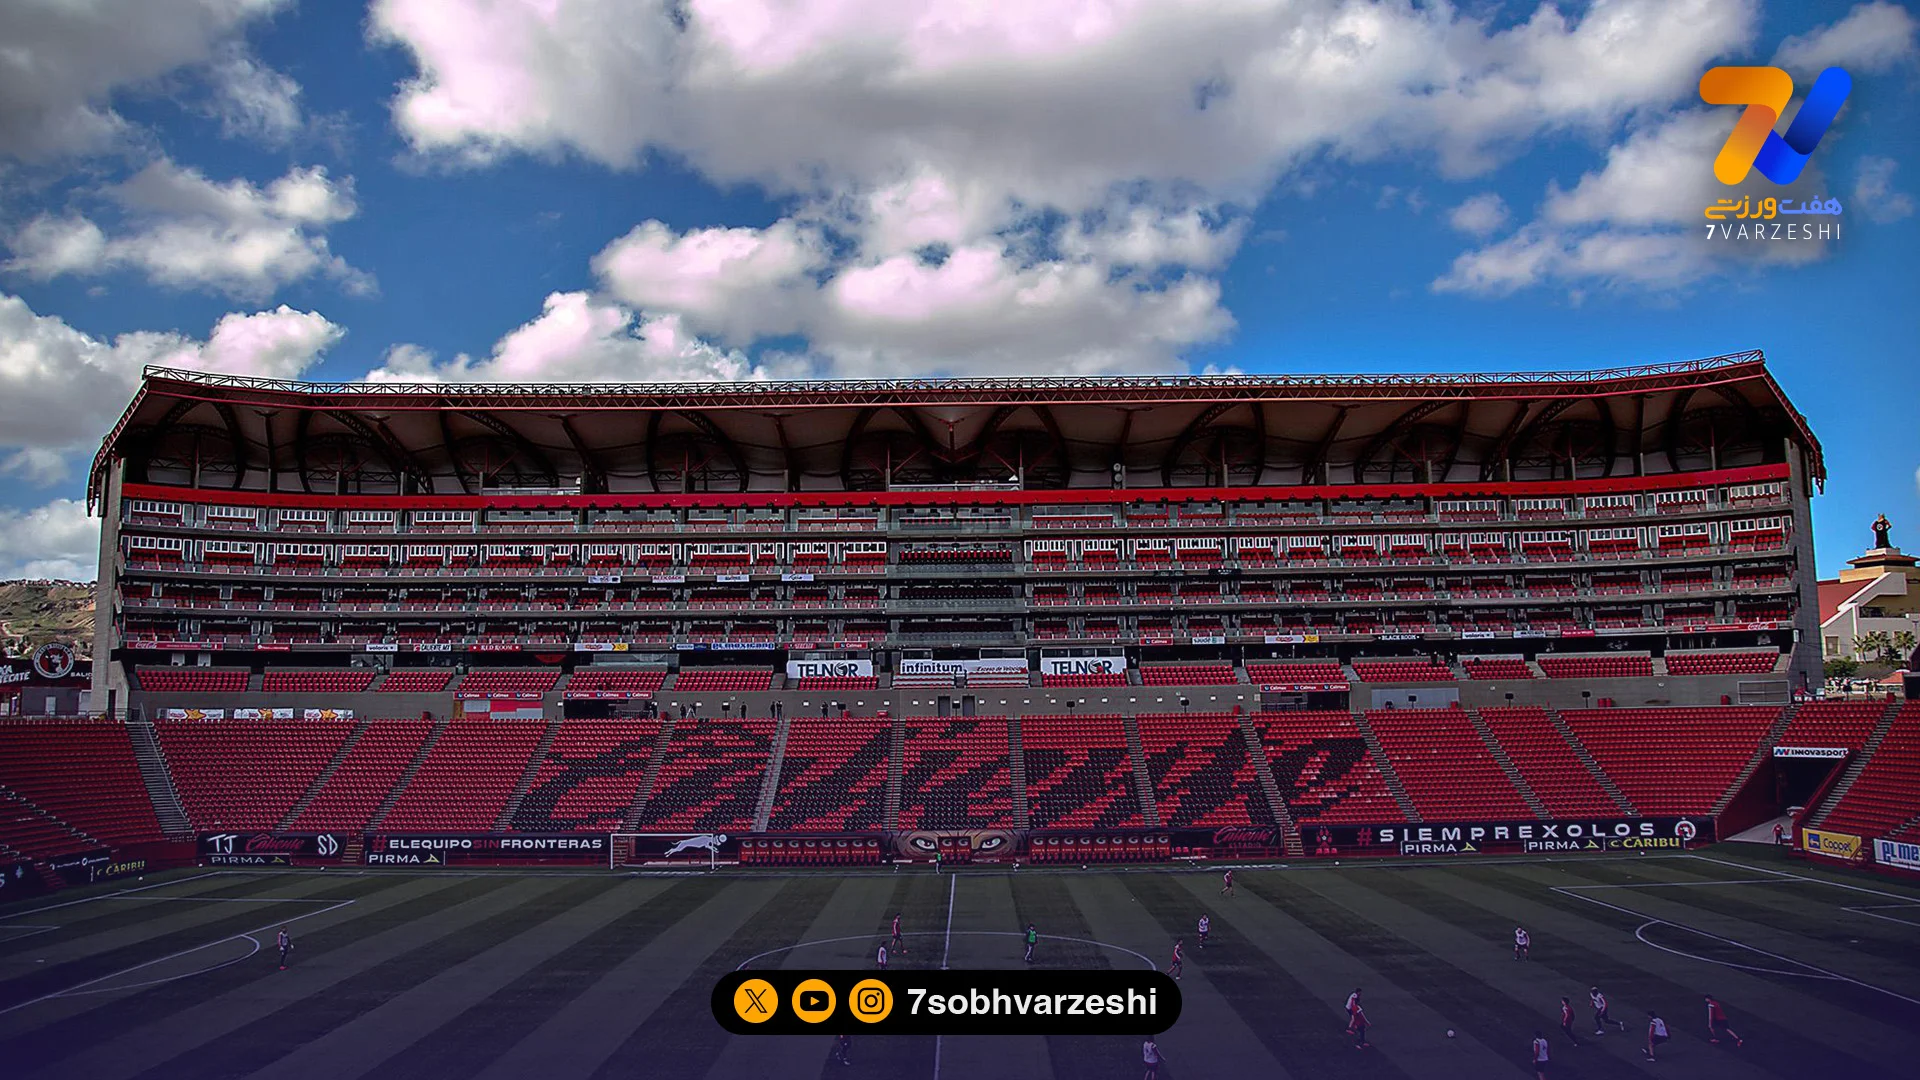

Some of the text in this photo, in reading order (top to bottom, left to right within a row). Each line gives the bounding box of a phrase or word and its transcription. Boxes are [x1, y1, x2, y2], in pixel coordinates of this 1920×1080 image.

[901, 662, 963, 673] infinitum
[206, 834, 238, 854] TJ
[317, 834, 339, 855] SD
[1405, 843, 1457, 853] PIRMA
[1529, 840, 1579, 850] PIRMA
[1623, 838, 1681, 848] CARIBU
[211, 856, 265, 864] PIRMA
[369, 854, 420, 864] PIRMA
